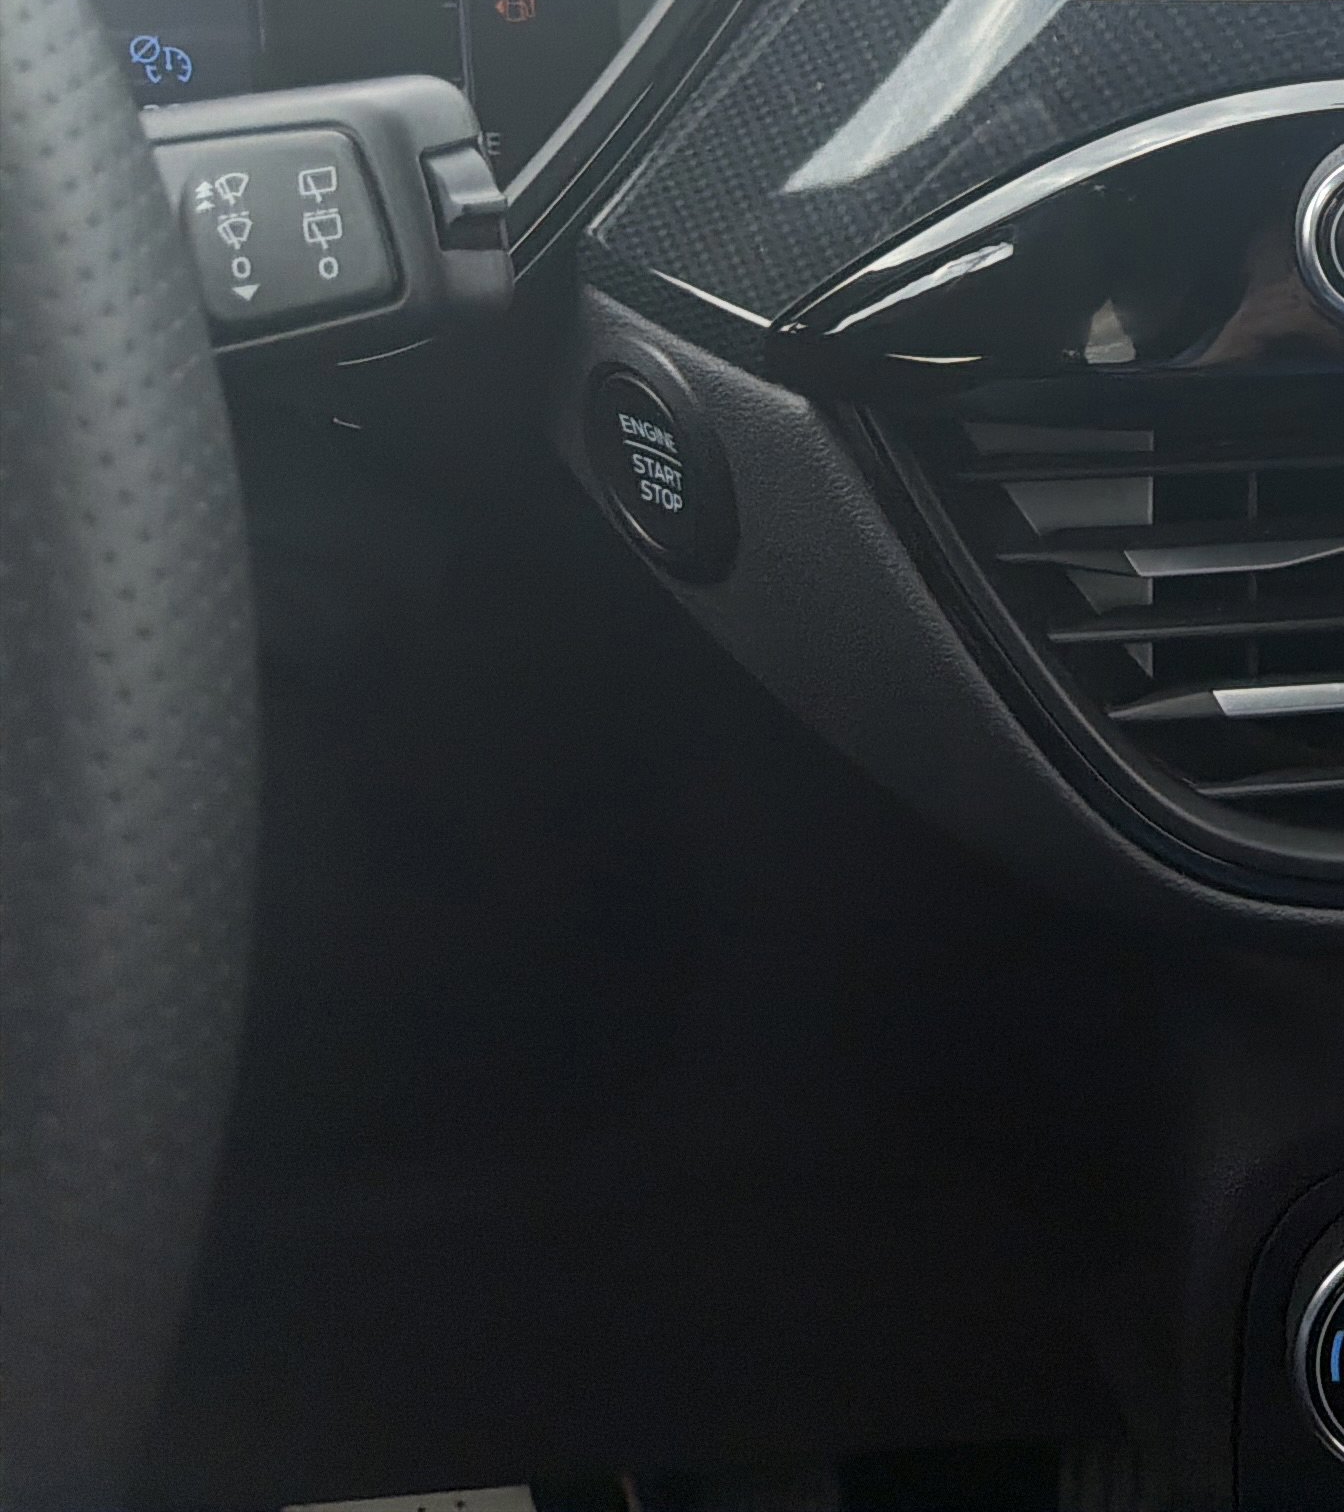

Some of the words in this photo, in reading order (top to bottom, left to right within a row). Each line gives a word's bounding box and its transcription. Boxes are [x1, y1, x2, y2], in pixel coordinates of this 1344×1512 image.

[618, 412, 678, 453] ENGINE
[632, 454, 682, 491] START
[640, 480, 683, 513] STOP
